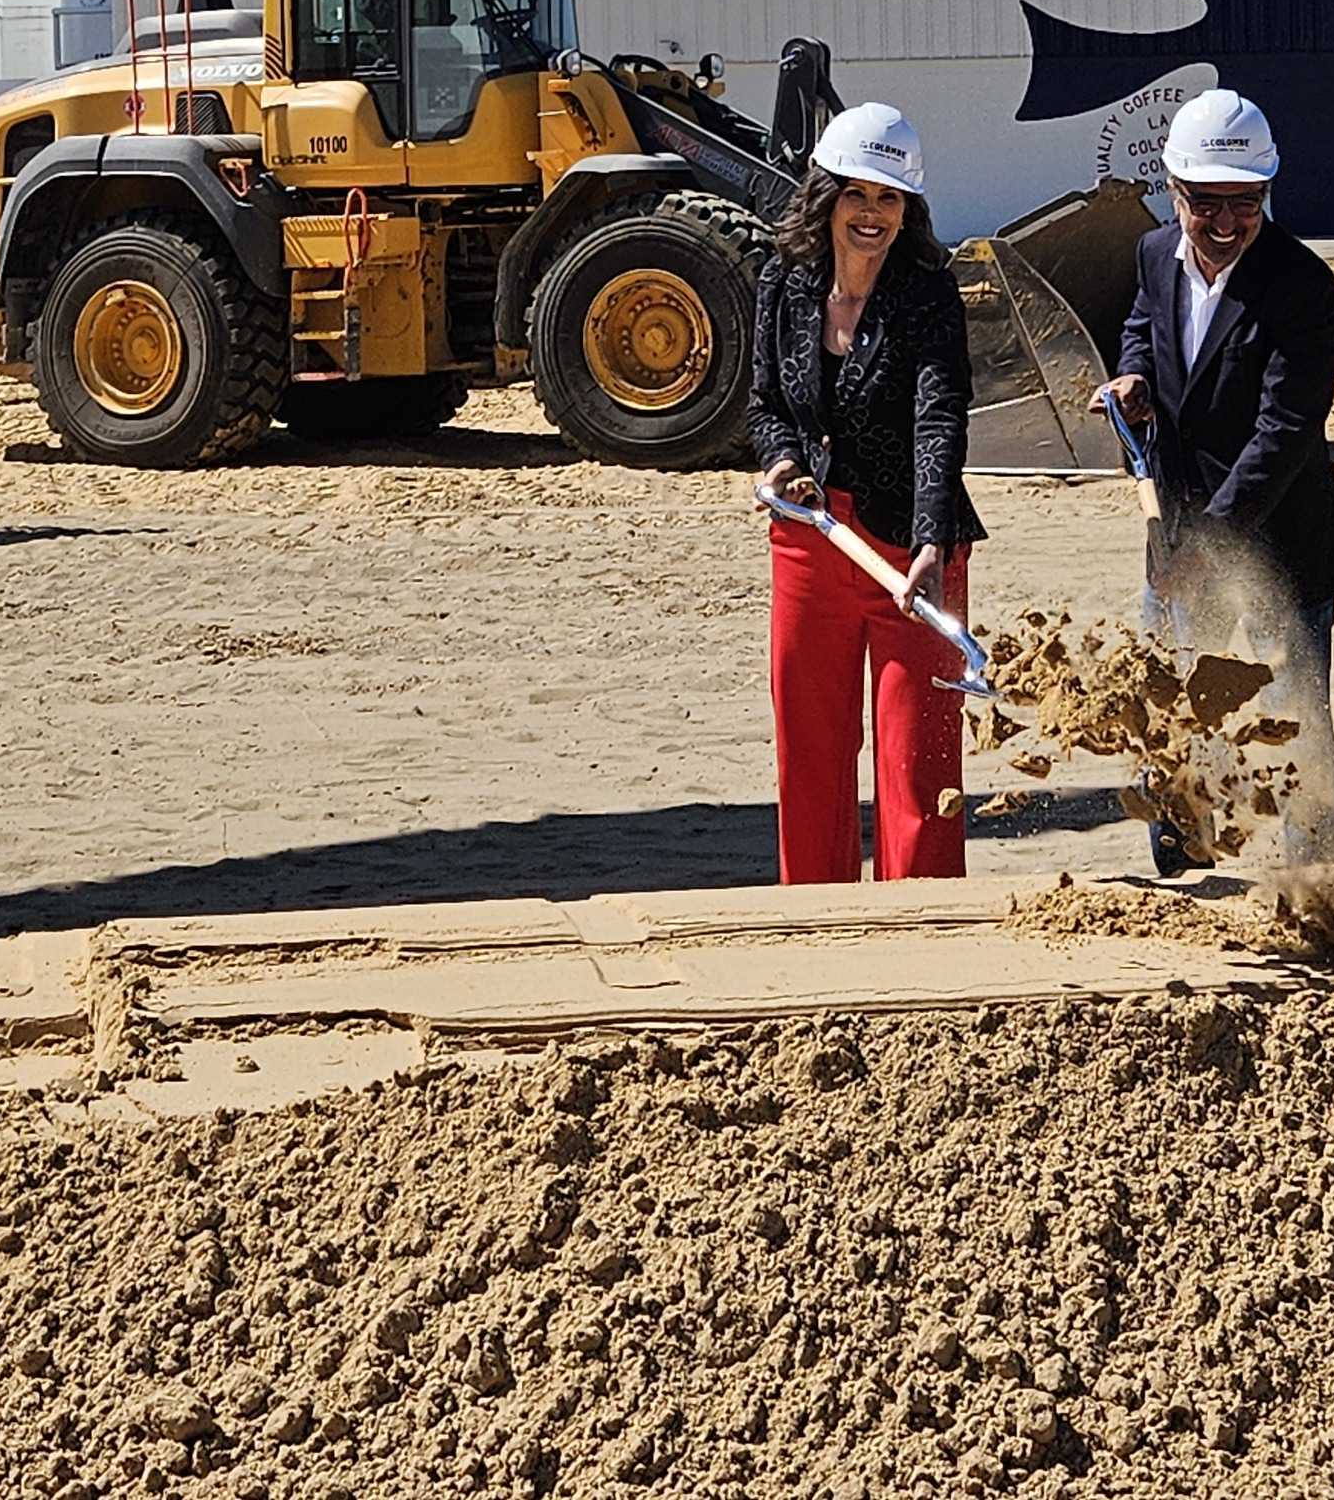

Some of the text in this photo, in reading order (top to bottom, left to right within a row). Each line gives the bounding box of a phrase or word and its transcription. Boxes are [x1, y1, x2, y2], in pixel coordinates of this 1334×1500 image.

[179, 63, 264, 78] VOLVO
[1148, 114, 1168, 130] LA
[1097, 113, 1122, 178] UALITY
[1123, 87, 1185, 115] COFFEE
[309, 136, 348, 154] 10100
